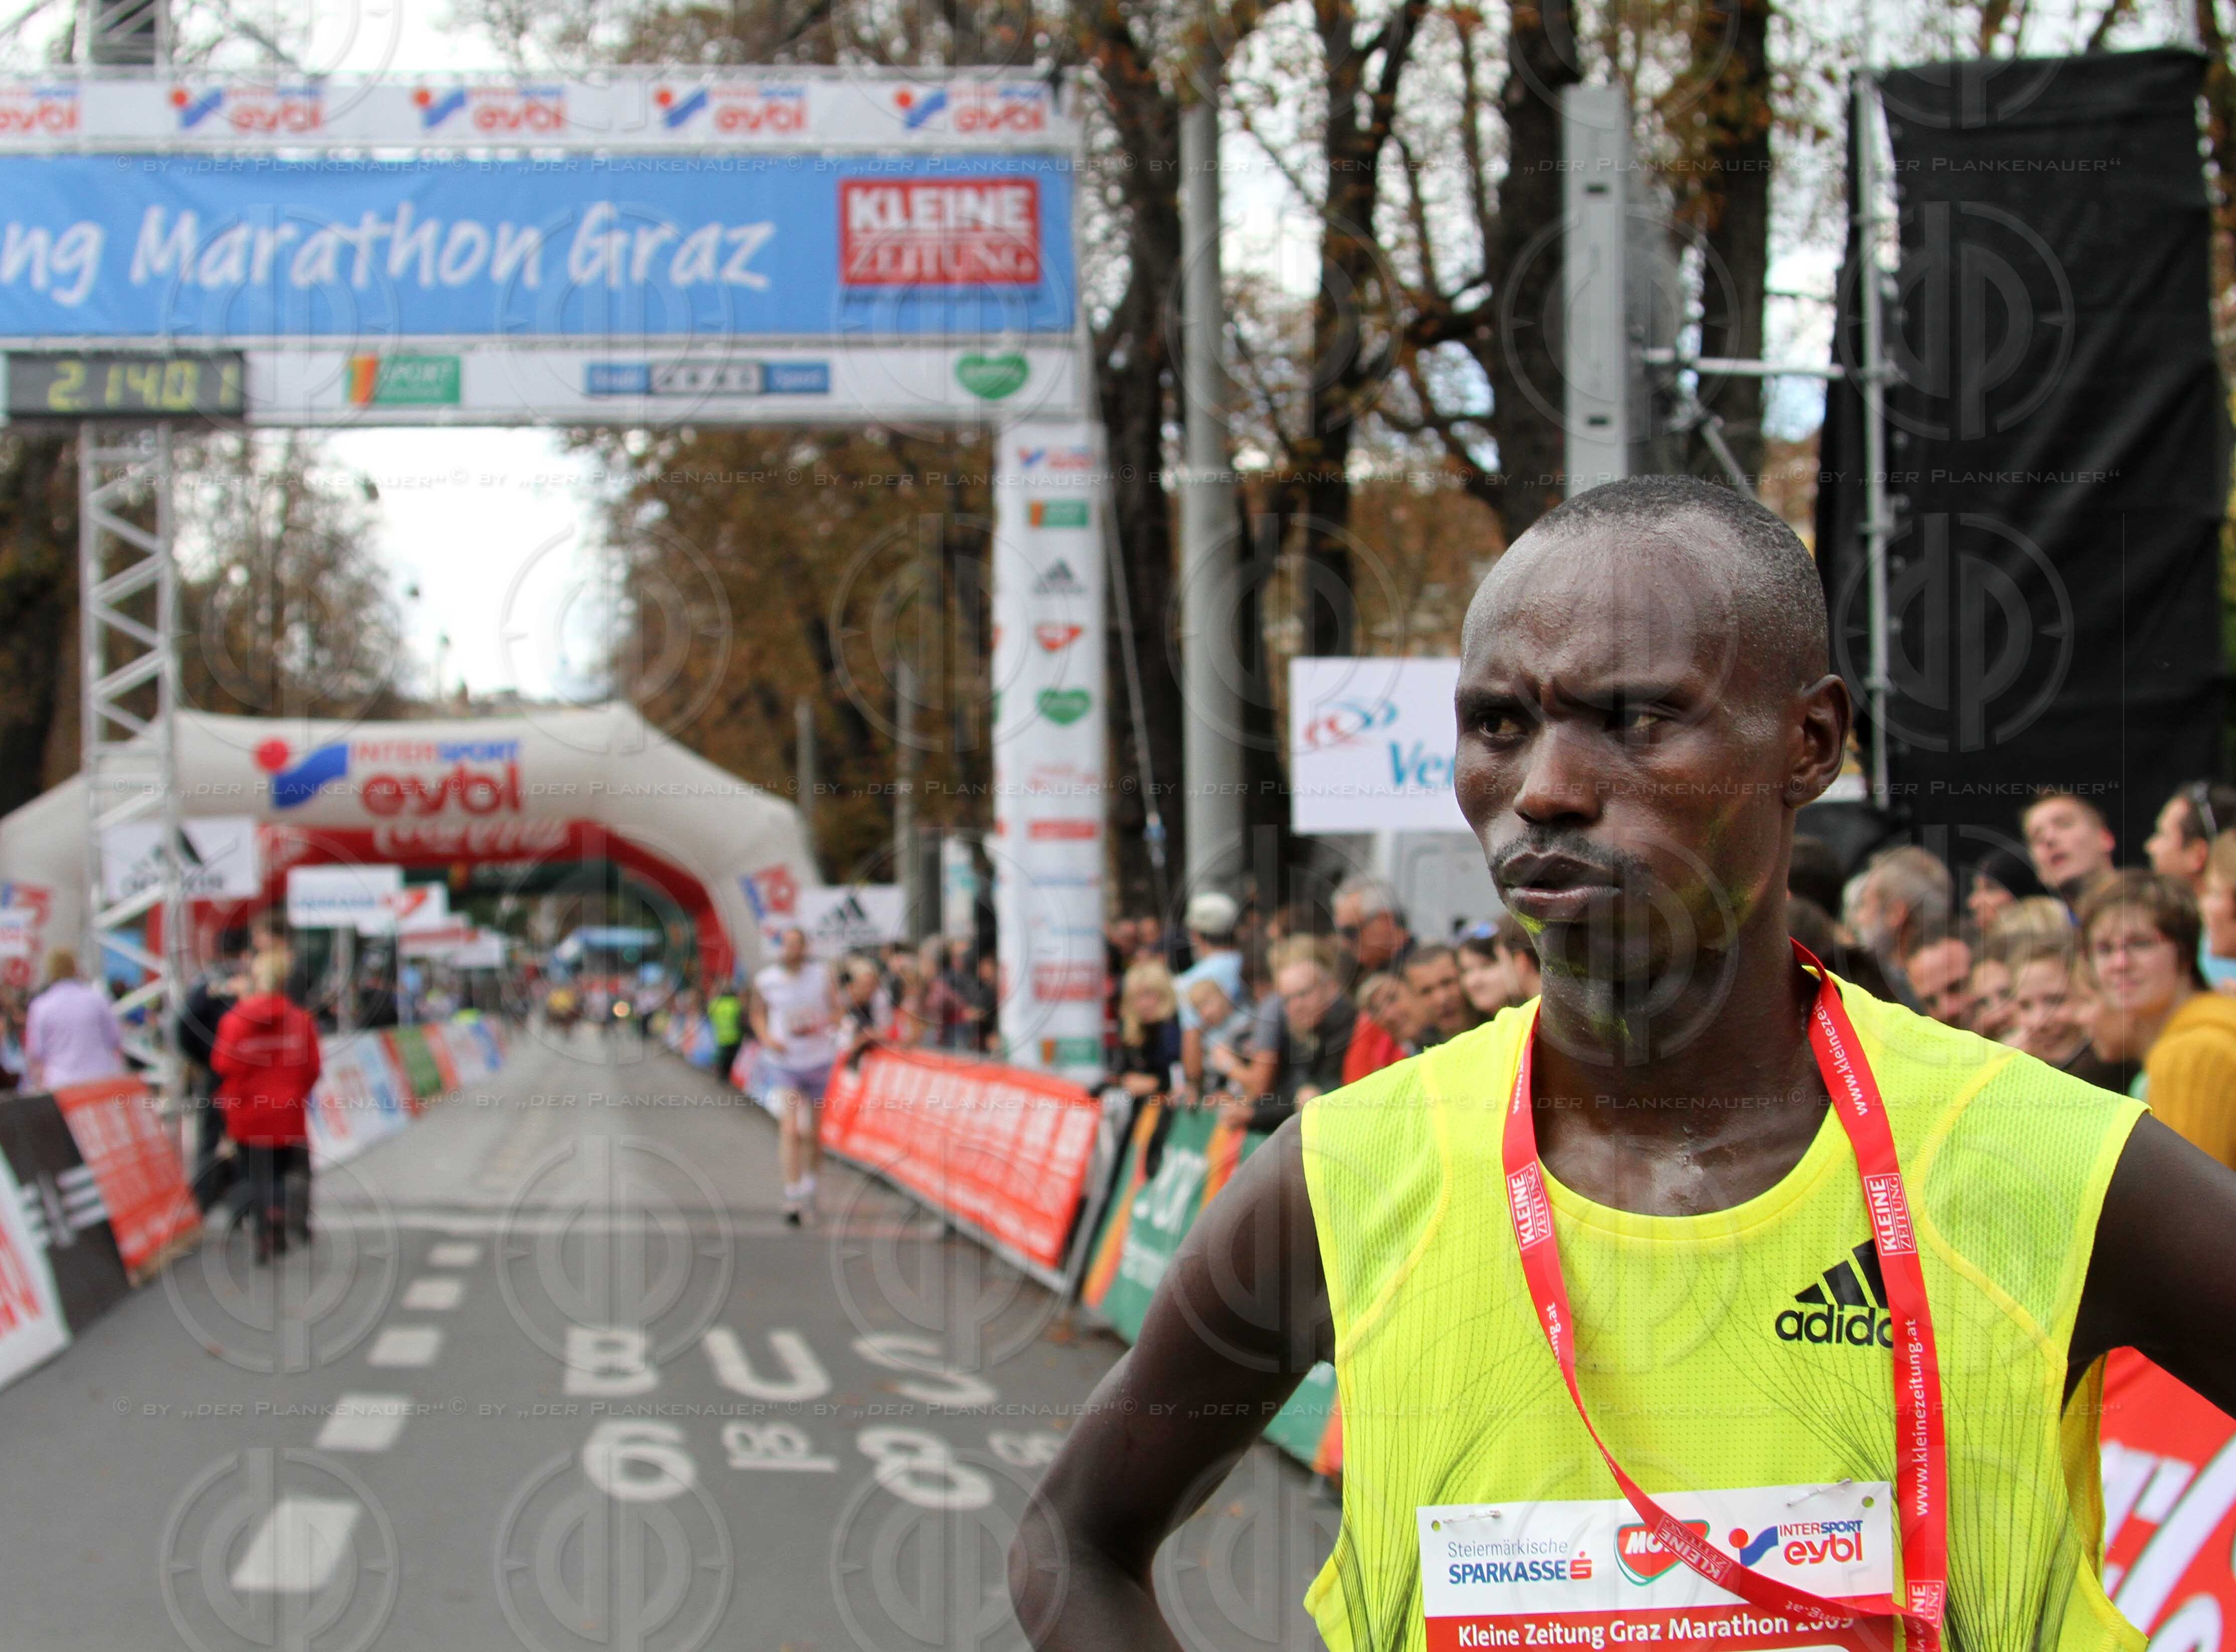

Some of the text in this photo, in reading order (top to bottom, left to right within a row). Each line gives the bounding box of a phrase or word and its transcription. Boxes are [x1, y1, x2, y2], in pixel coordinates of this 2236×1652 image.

[848, 186, 1032, 233] KLEINE
[129, 201, 544, 290] Marathon
[568, 201, 777, 291] Graz
[360, 759, 521, 818] eybl
[1511, 1173, 1535, 1245] KLEINE
[1526, 1167, 1549, 1237] ZEITUNG
[1869, 1178, 1898, 1251] KLEINE
[1888, 1177, 1912, 1250] ZEITUNG
[1905, 1319, 1928, 1517] www.kleinezeitung.at
[1448, 1537, 1568, 1559] Steiermärkische
[1657, 1528, 1723, 1580] KLEINE
[1779, 1520, 1863, 1537] INTERSPORT
[1784, 1533, 1863, 1566] eybl
[1449, 1559, 1567, 1584] SPARKASSE
[1458, 1624, 1520, 1647] Kleine
[1524, 1622, 1605, 1650] Zeitung
[1609, 1620, 1662, 1643] Graz
[1667, 1612, 1789, 1640] Marathon
